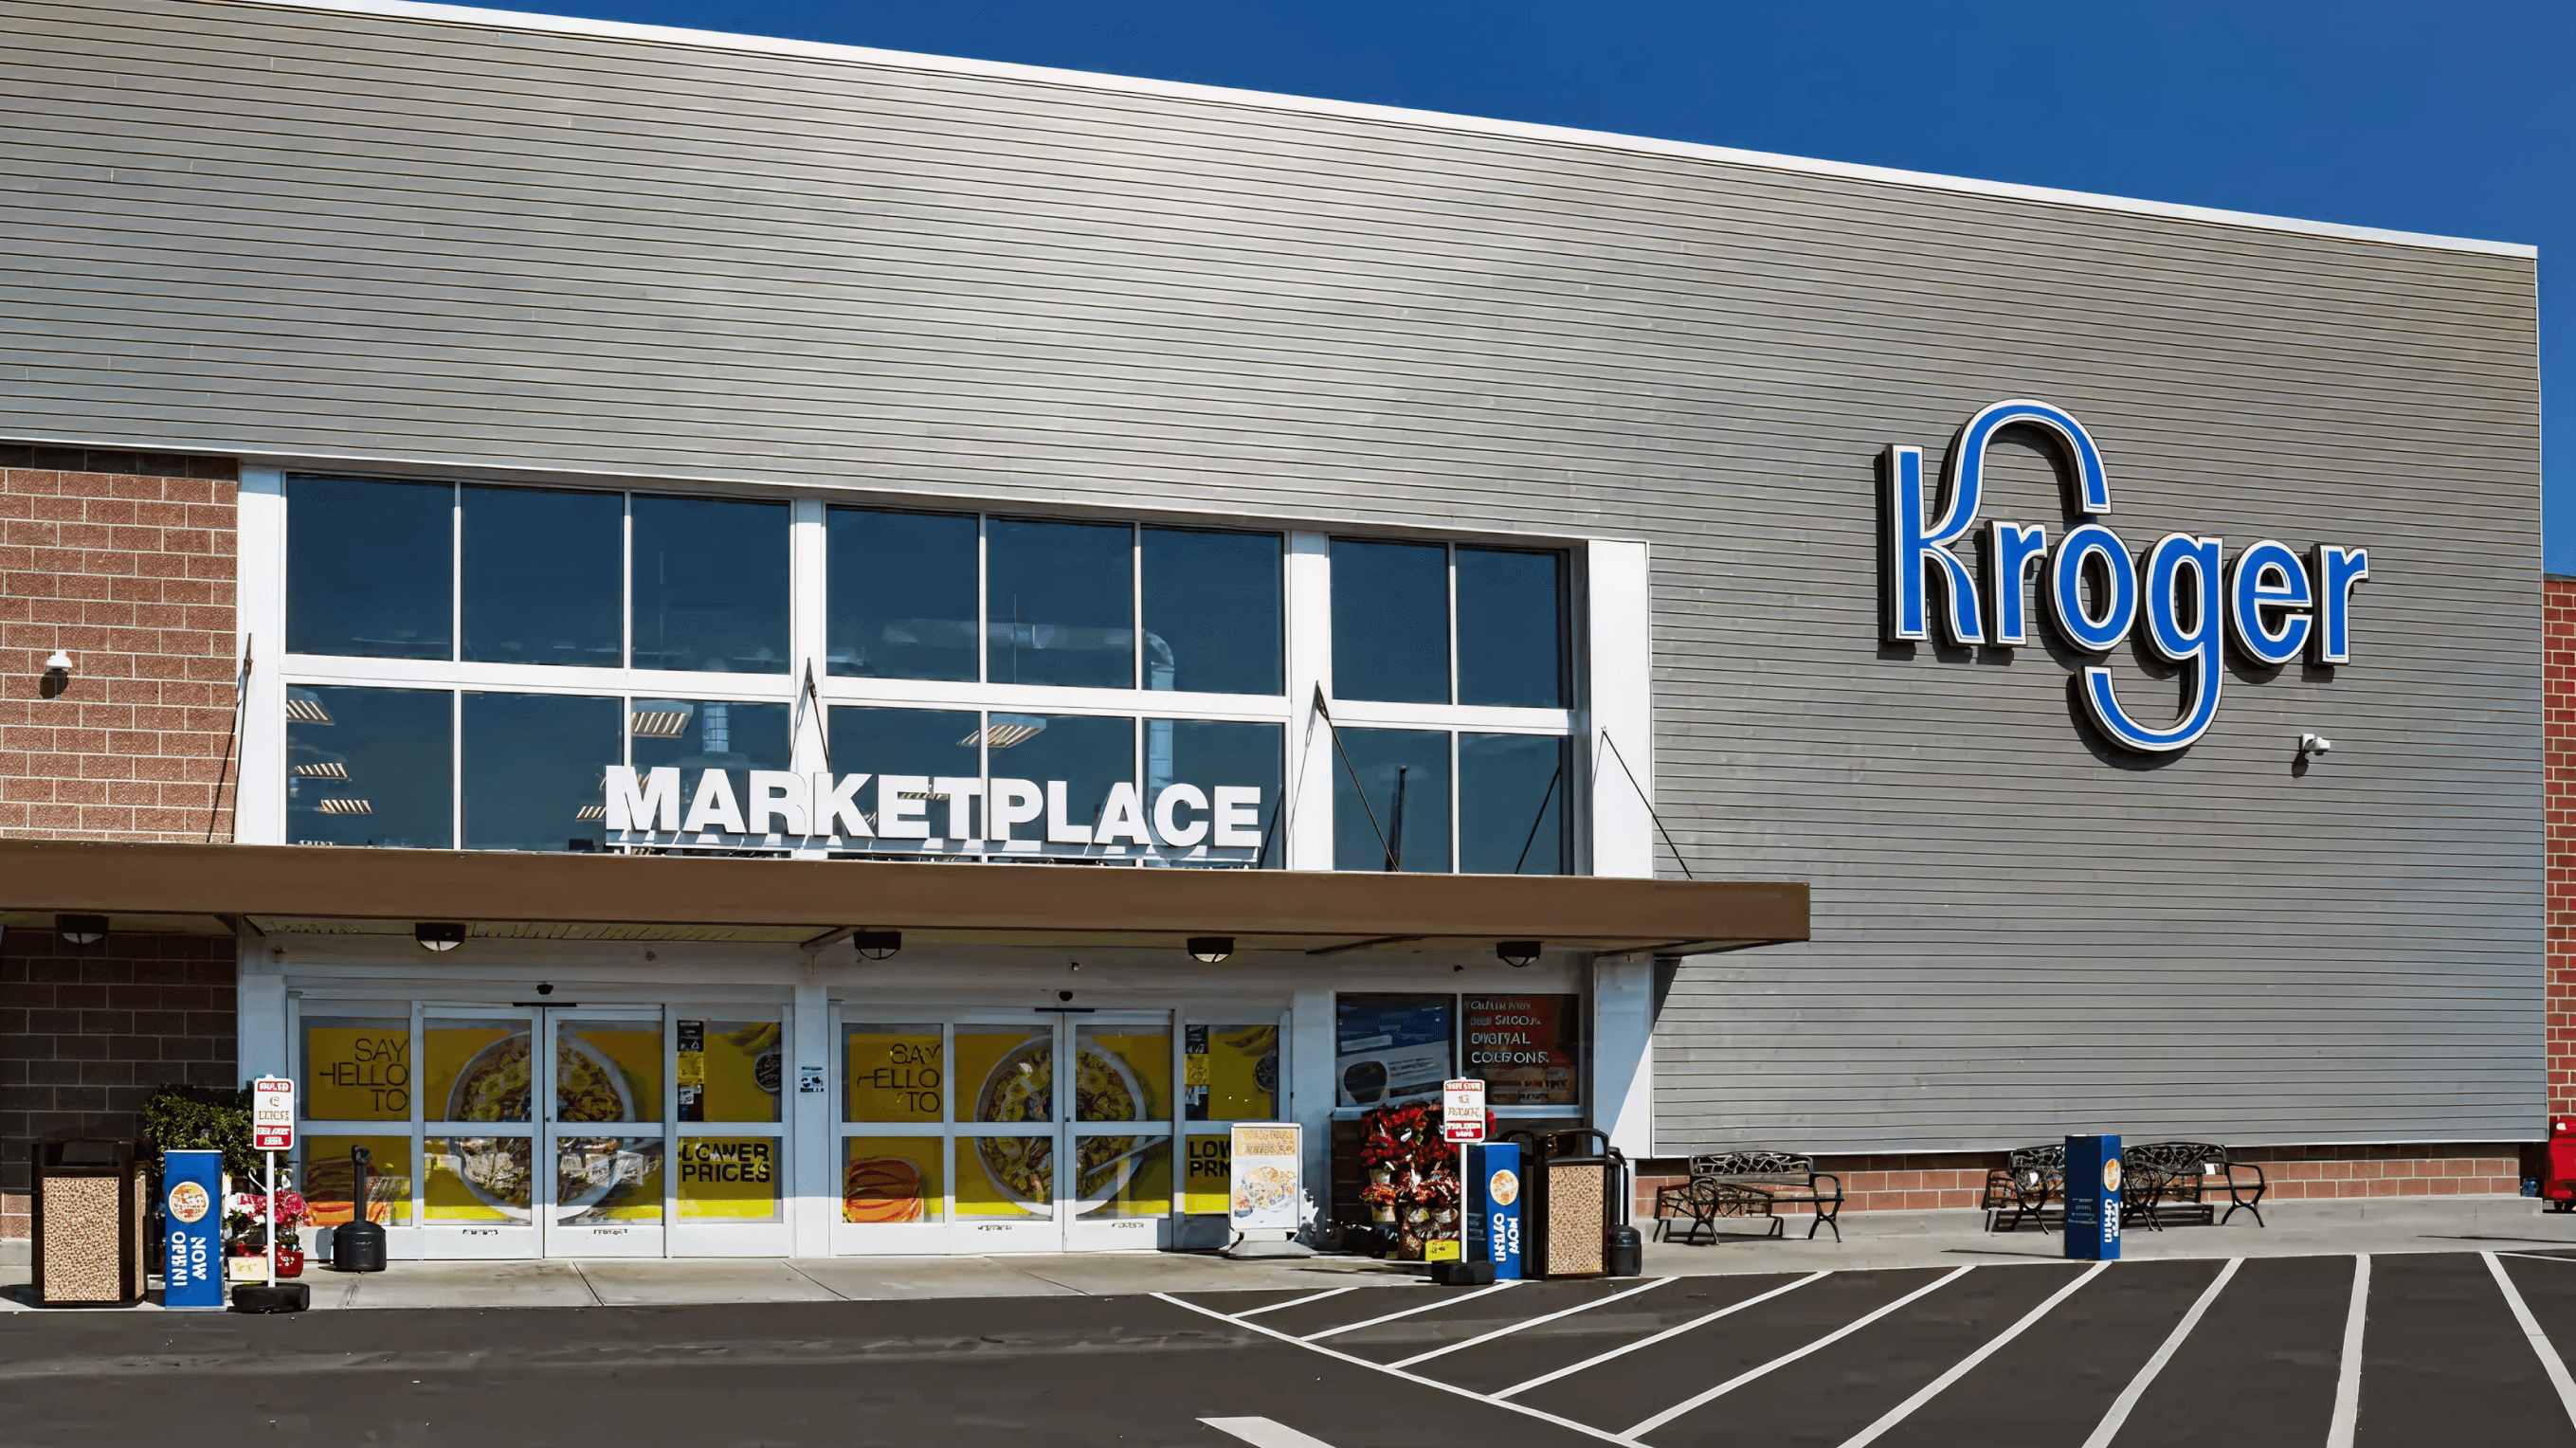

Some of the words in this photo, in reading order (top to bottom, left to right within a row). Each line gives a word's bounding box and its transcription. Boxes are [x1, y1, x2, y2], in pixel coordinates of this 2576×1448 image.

[1892, 398, 2369, 752] Kroger
[605, 765, 1262, 848] MARKETPLACE
[354, 1038, 408, 1061] SAY
[370, 1089, 408, 1112] TO
[906, 1092, 940, 1113] TO
[681, 1143, 770, 1162] LOWER
[681, 1164, 771, 1183] PRICES
[191, 1237, 207, 1280] NOW
